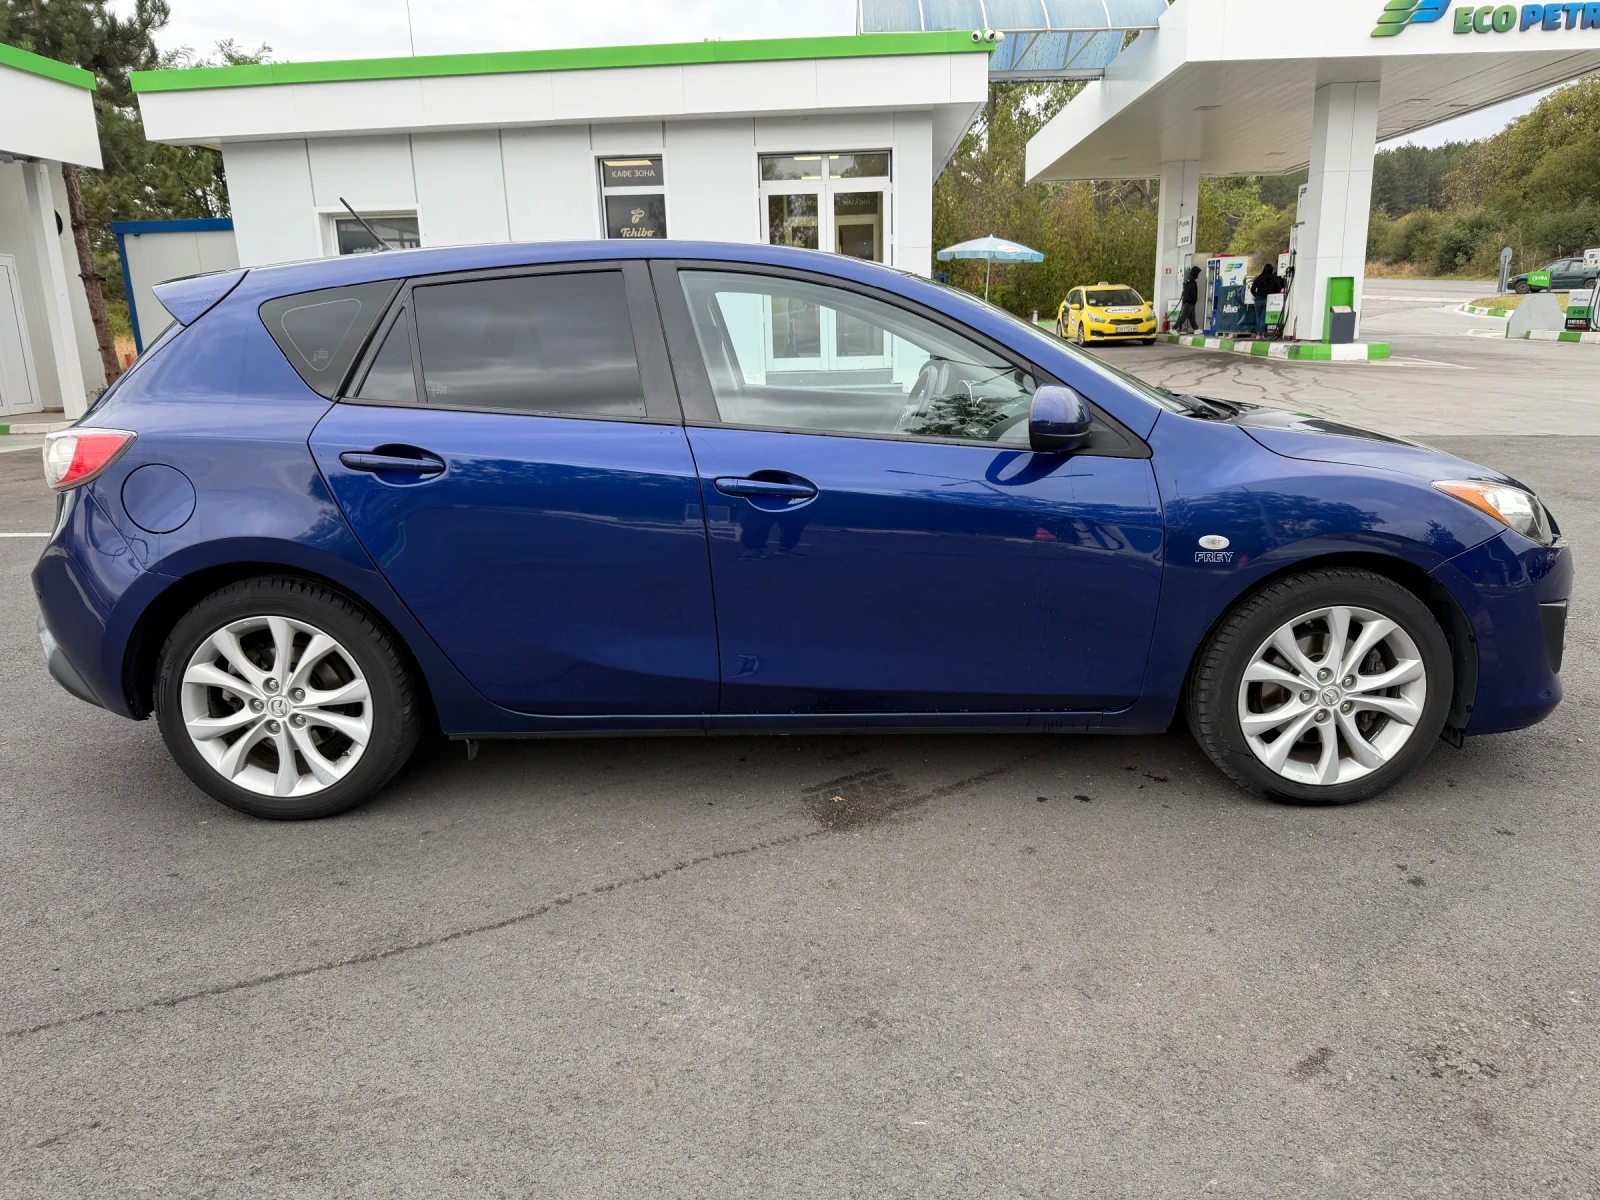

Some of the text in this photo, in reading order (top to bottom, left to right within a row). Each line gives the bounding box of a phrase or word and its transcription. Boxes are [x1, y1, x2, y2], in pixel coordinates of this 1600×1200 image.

[611, 169, 656, 178] КАФЕ ЗОНА
[620, 227, 656, 238] Tchibo
[1194, 551, 1234, 563] FREY
